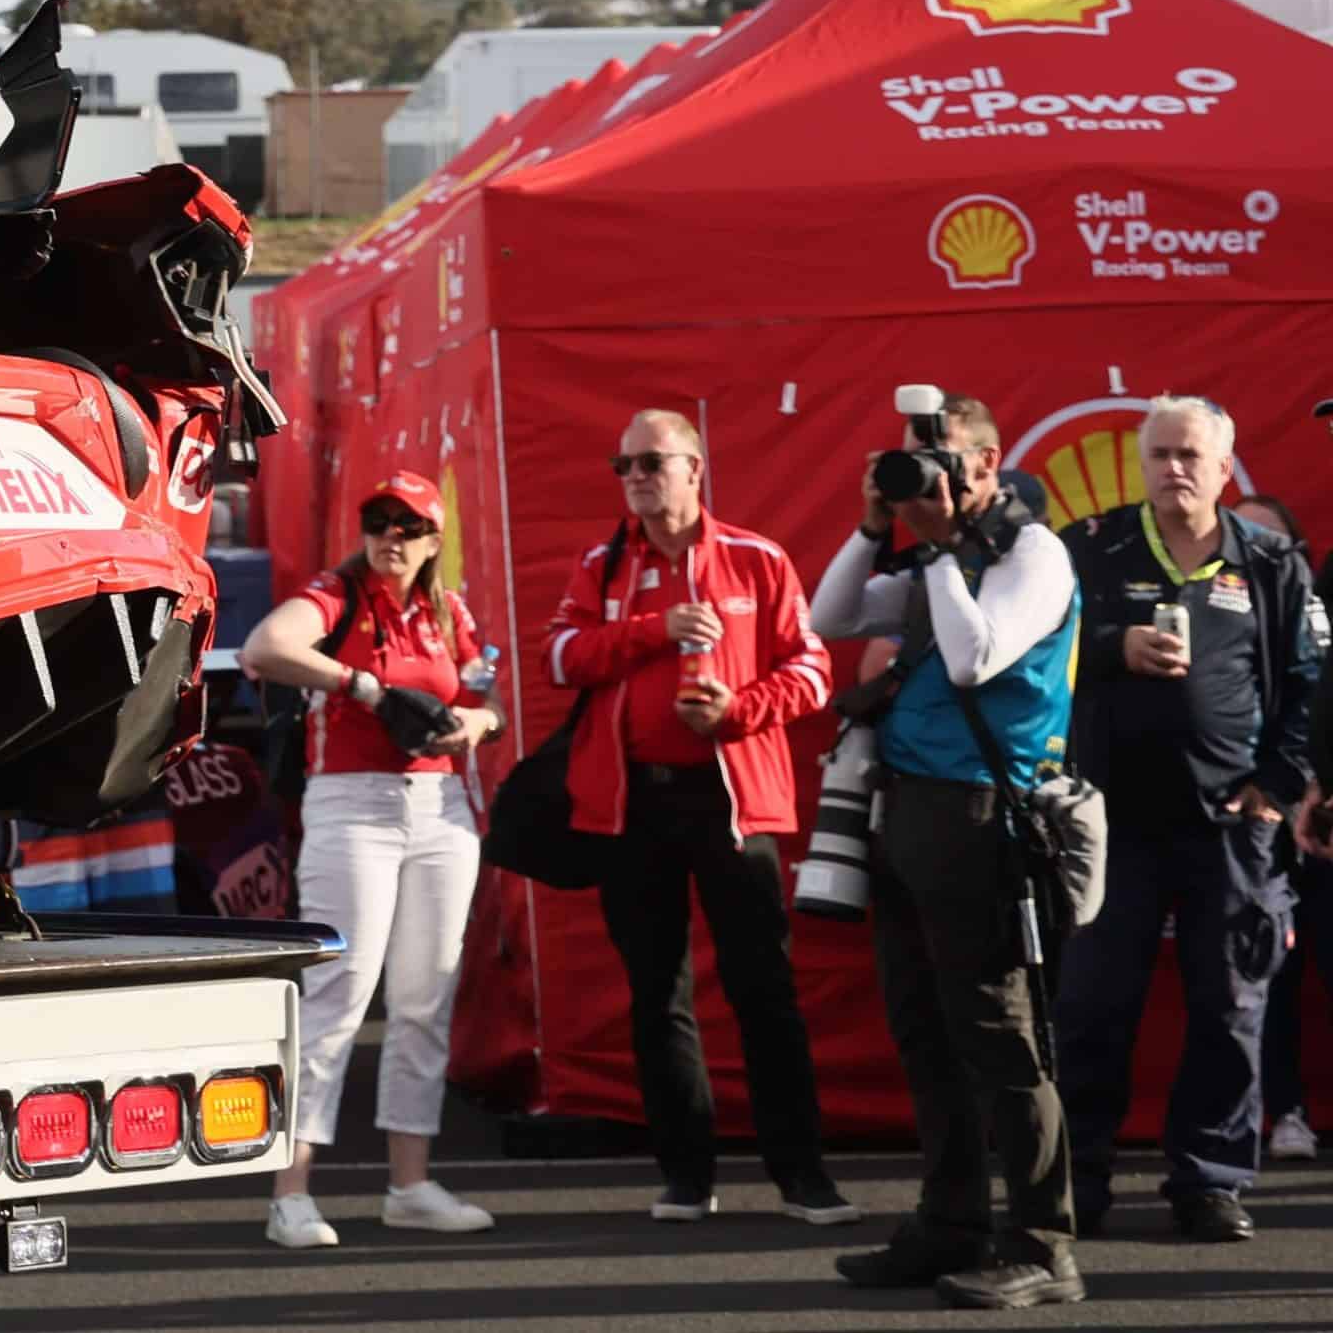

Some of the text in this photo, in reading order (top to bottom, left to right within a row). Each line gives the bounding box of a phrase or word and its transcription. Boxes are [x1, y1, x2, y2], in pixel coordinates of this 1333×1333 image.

[881, 66, 1004, 98] Shell
[886, 90, 1220, 125] V-Power
[917, 116, 1165, 141] Racing Team
[1074, 189, 1146, 218] Shell
[1076, 220, 1267, 255] V-Power
[1091, 257, 1230, 281] Racing Team
